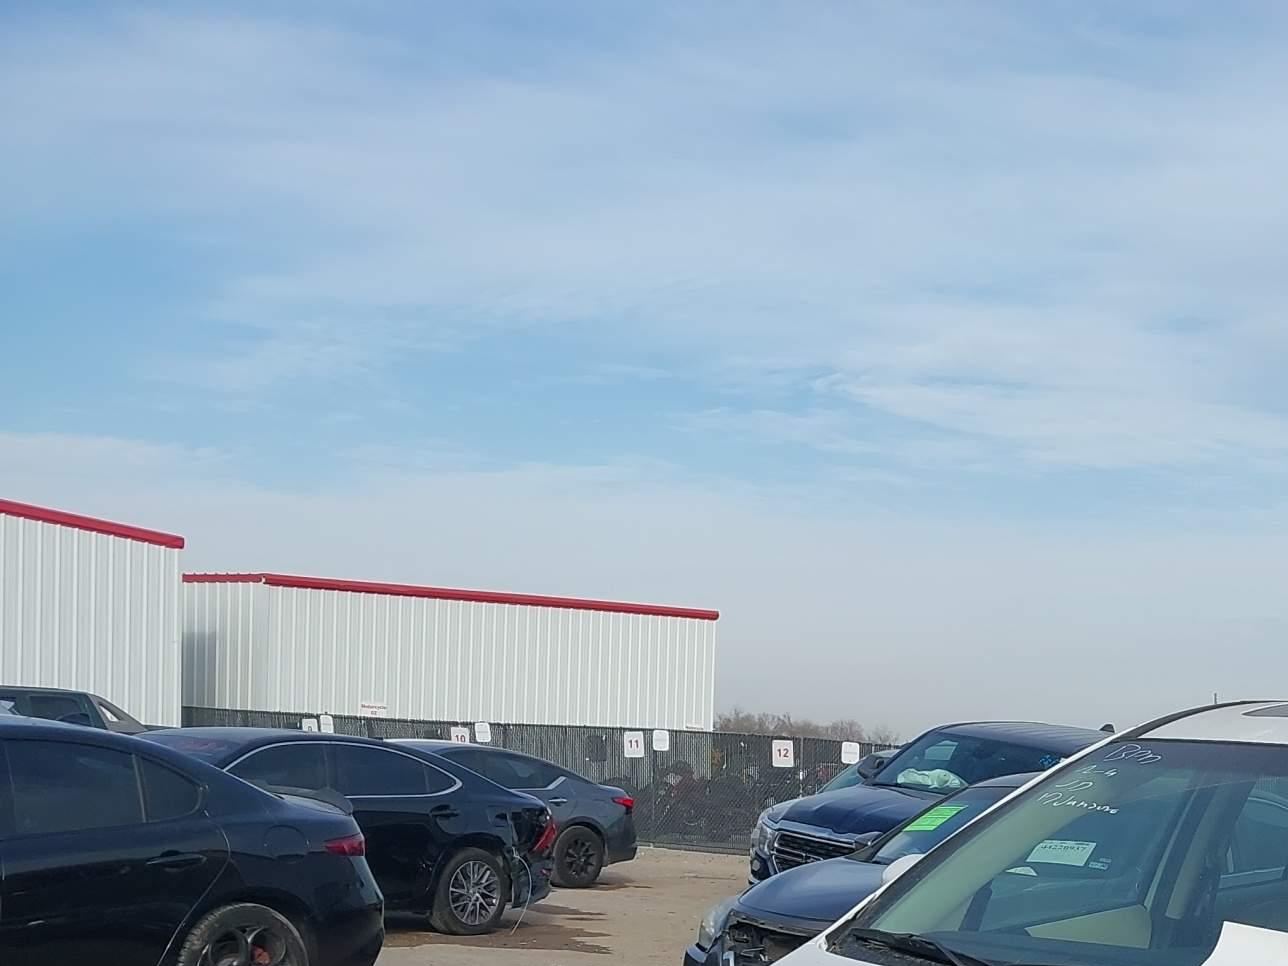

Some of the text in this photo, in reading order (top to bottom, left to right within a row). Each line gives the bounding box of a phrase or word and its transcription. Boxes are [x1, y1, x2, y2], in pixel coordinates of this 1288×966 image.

[455, 735, 466, 743] 10
[628, 739, 639, 749] 11
[777, 748, 789, 758] 12
